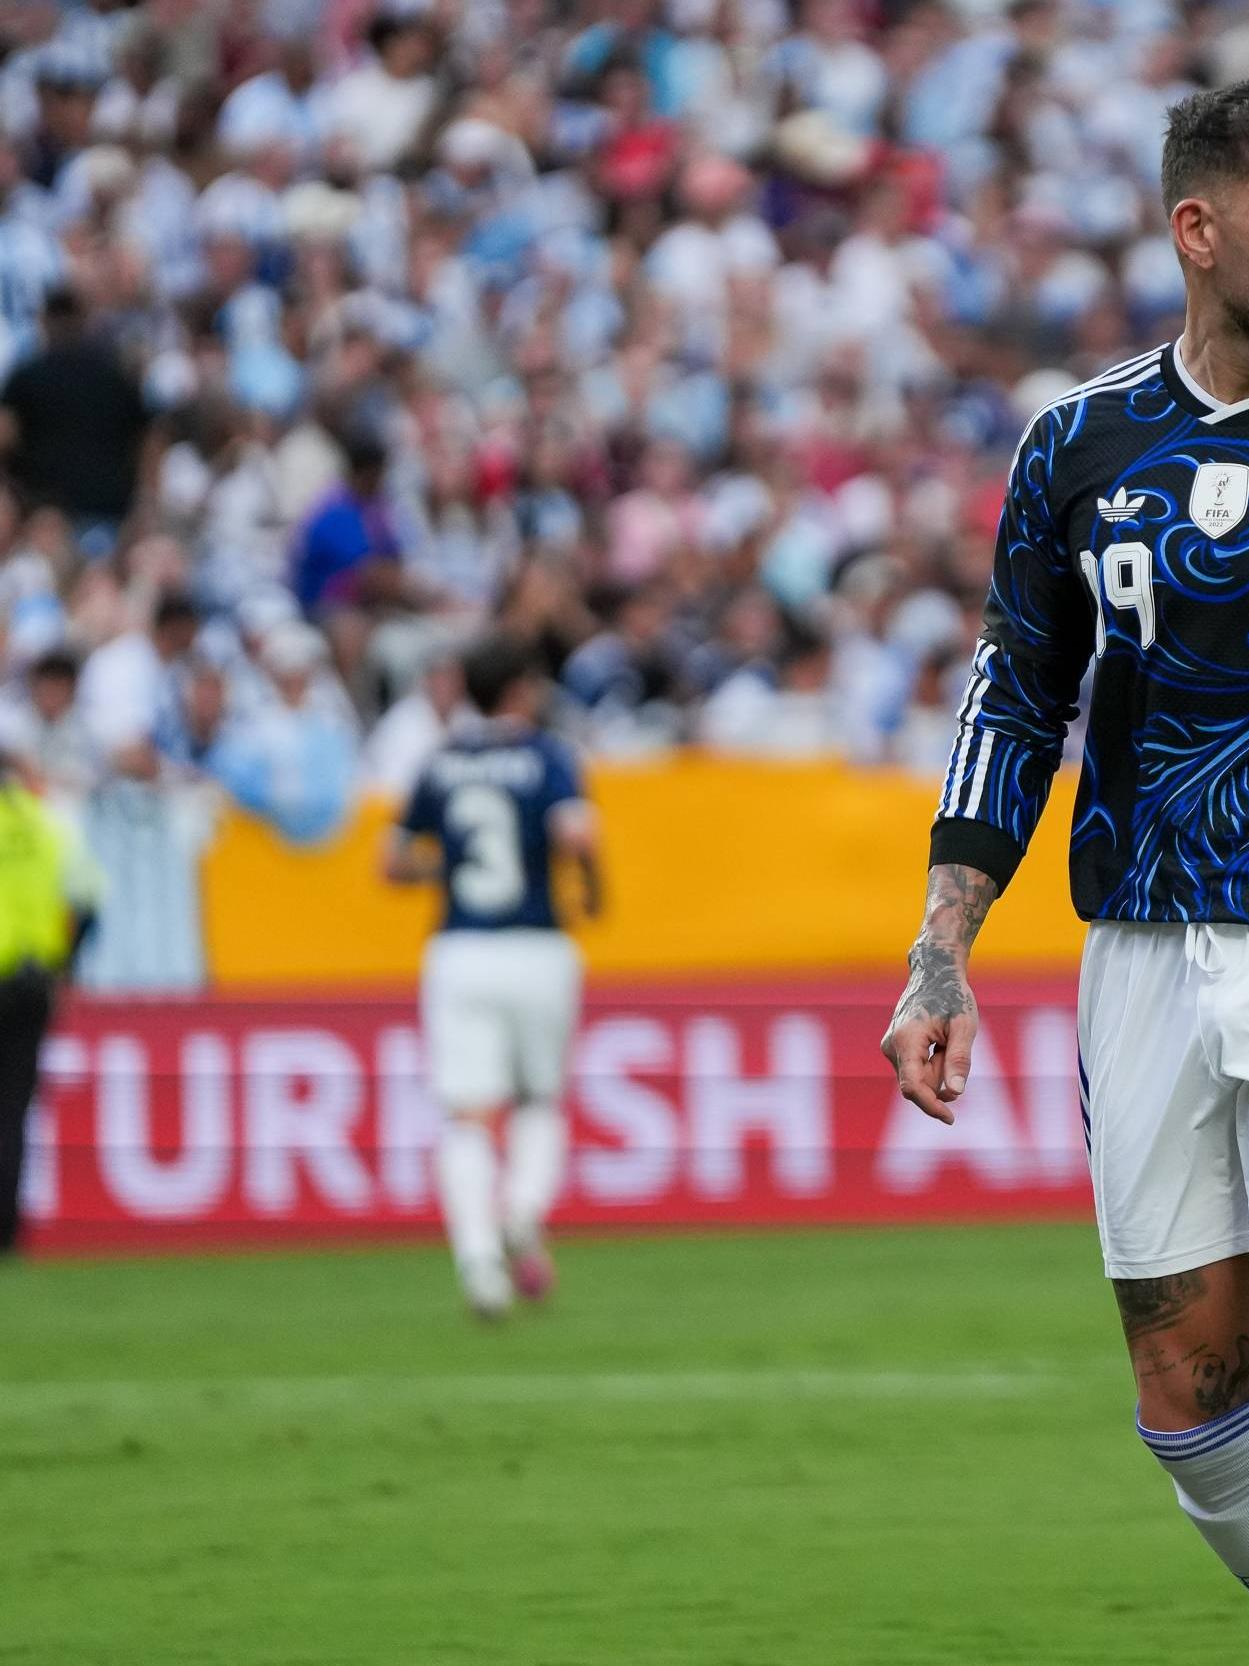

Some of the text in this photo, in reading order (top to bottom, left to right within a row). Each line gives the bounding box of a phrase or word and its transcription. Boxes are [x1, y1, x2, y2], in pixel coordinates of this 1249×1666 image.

[1205, 509, 1230, 518] FIFA
[1079, 541, 1155, 659] 19
[446, 783, 525, 917] 3
[16, 1012, 840, 1228] URKSH
